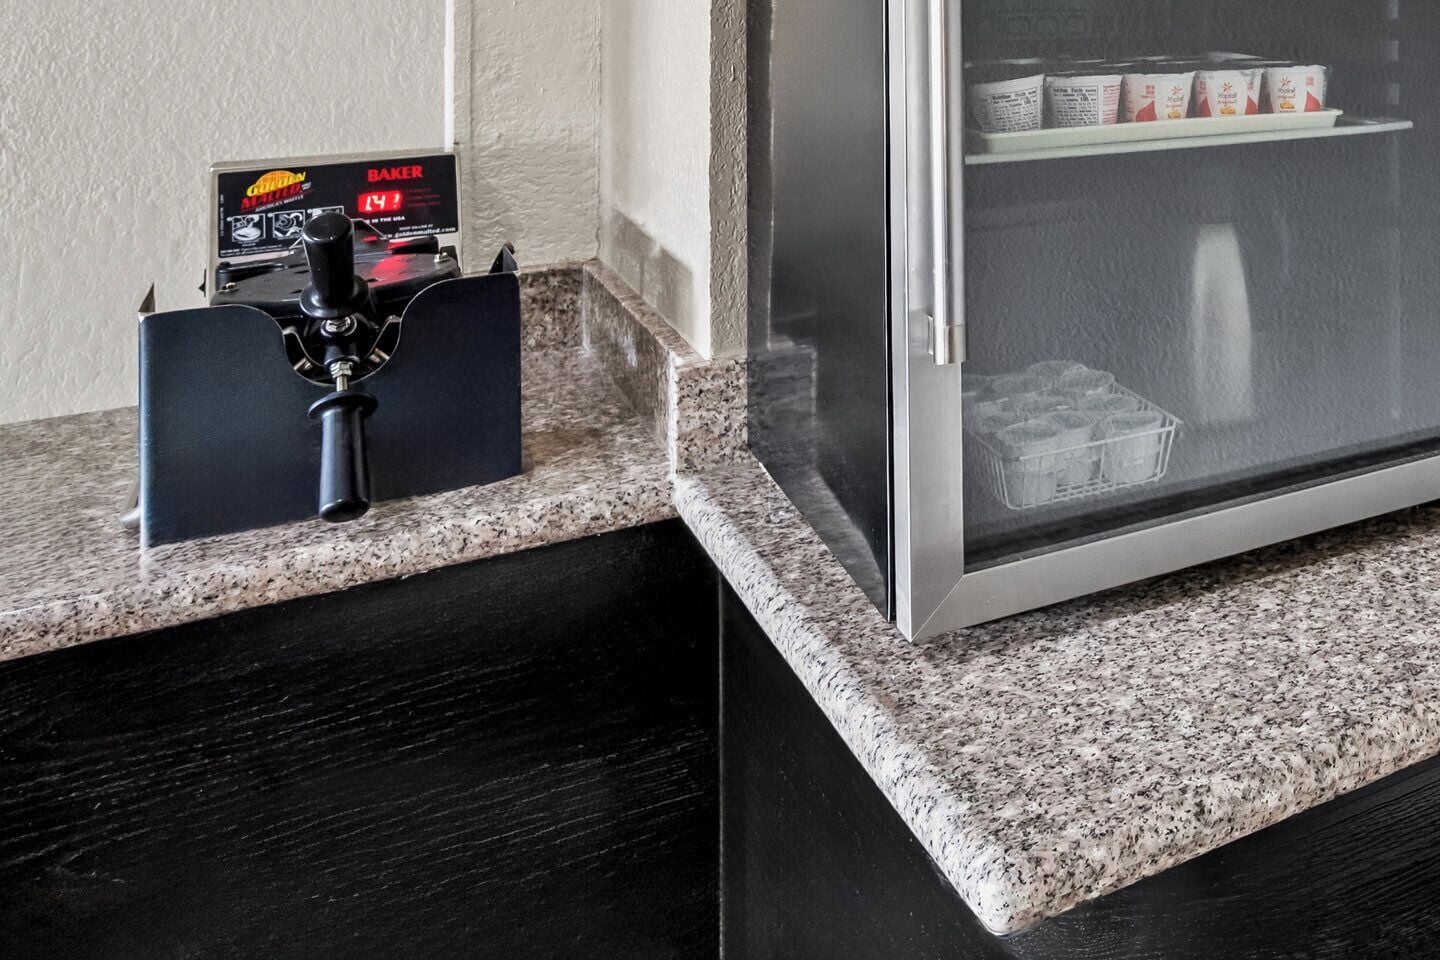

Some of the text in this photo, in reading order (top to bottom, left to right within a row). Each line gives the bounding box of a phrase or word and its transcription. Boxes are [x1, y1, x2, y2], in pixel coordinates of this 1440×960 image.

[246, 171, 306, 197] GOLDEN
[367, 165, 424, 182] BAKER
[240, 182, 302, 209] MALTED
